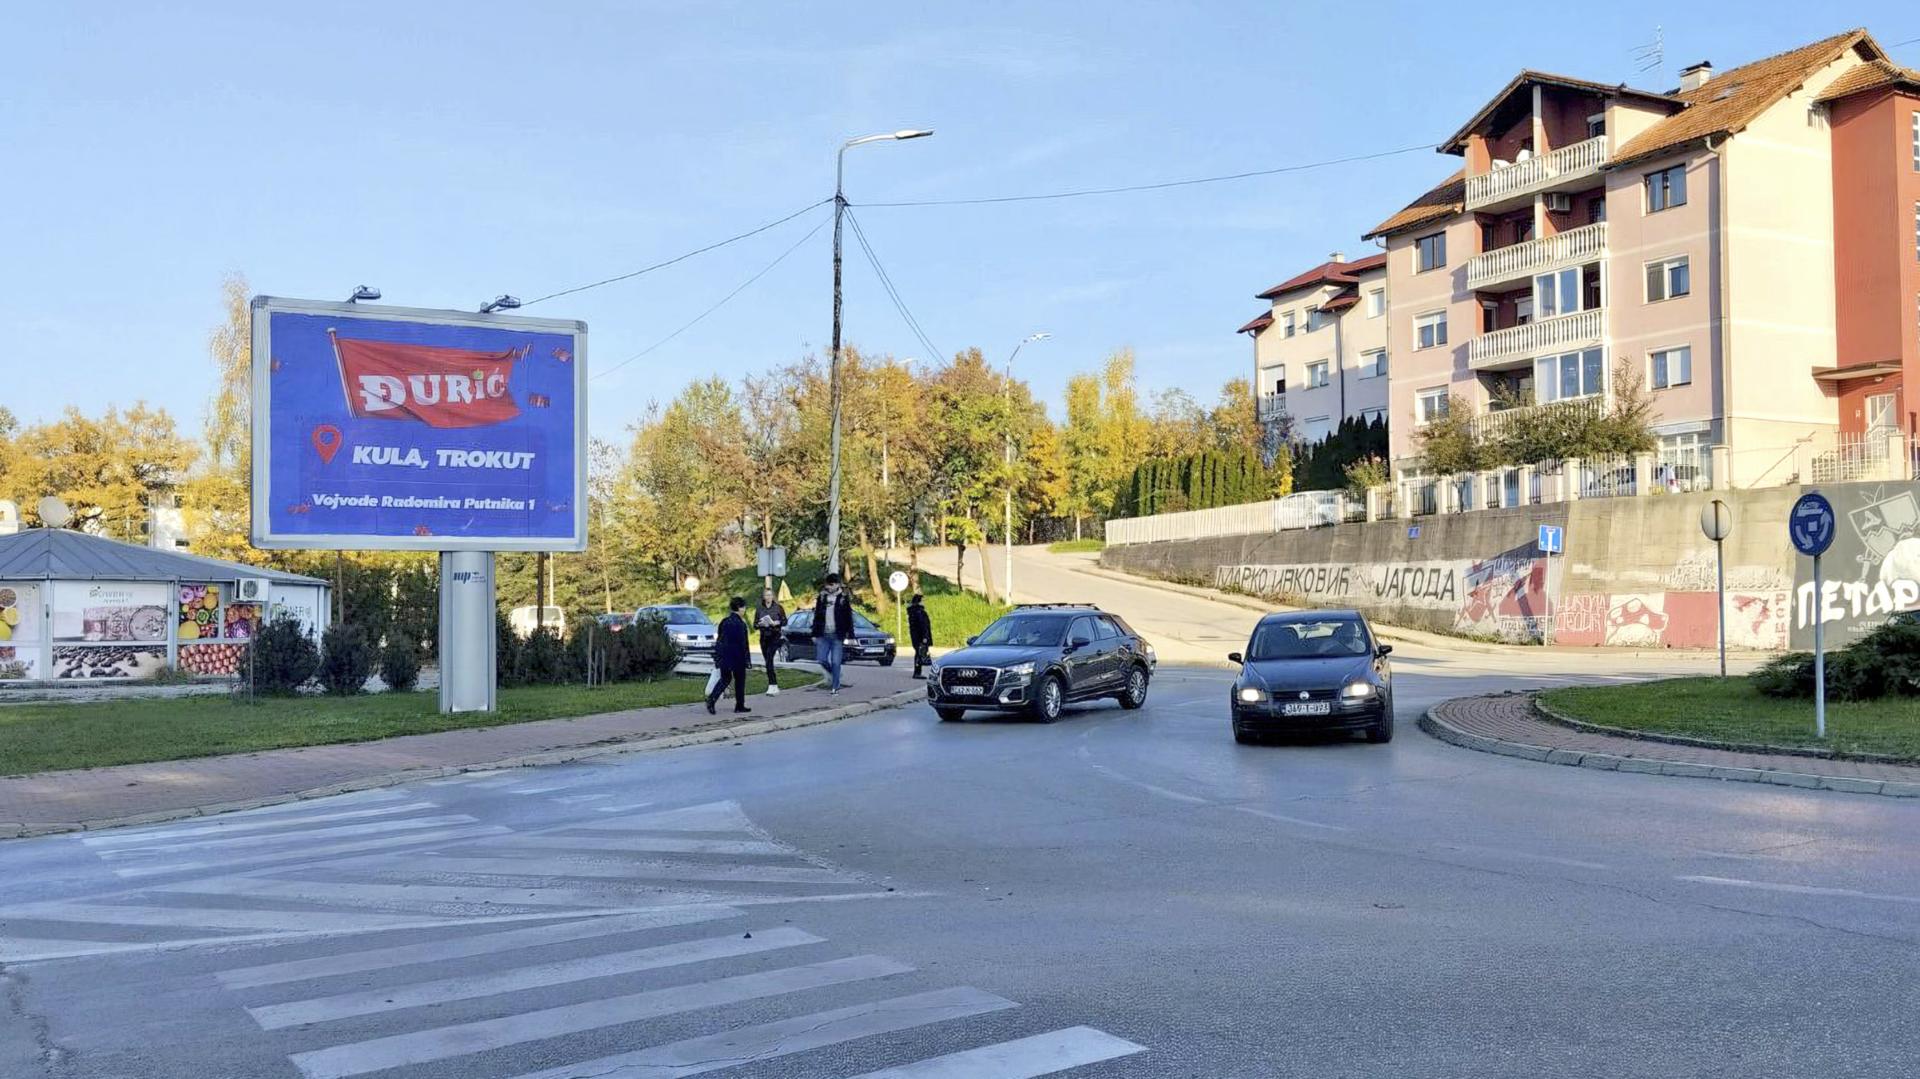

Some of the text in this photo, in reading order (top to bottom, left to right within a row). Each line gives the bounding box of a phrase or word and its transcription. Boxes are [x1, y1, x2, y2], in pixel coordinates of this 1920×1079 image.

[352, 445, 535, 470] KULA, TROKUT
[312, 493, 535, 510] Vojvode Radomira Putnika 1
[1375, 567, 1456, 601] ЈАГОДА
